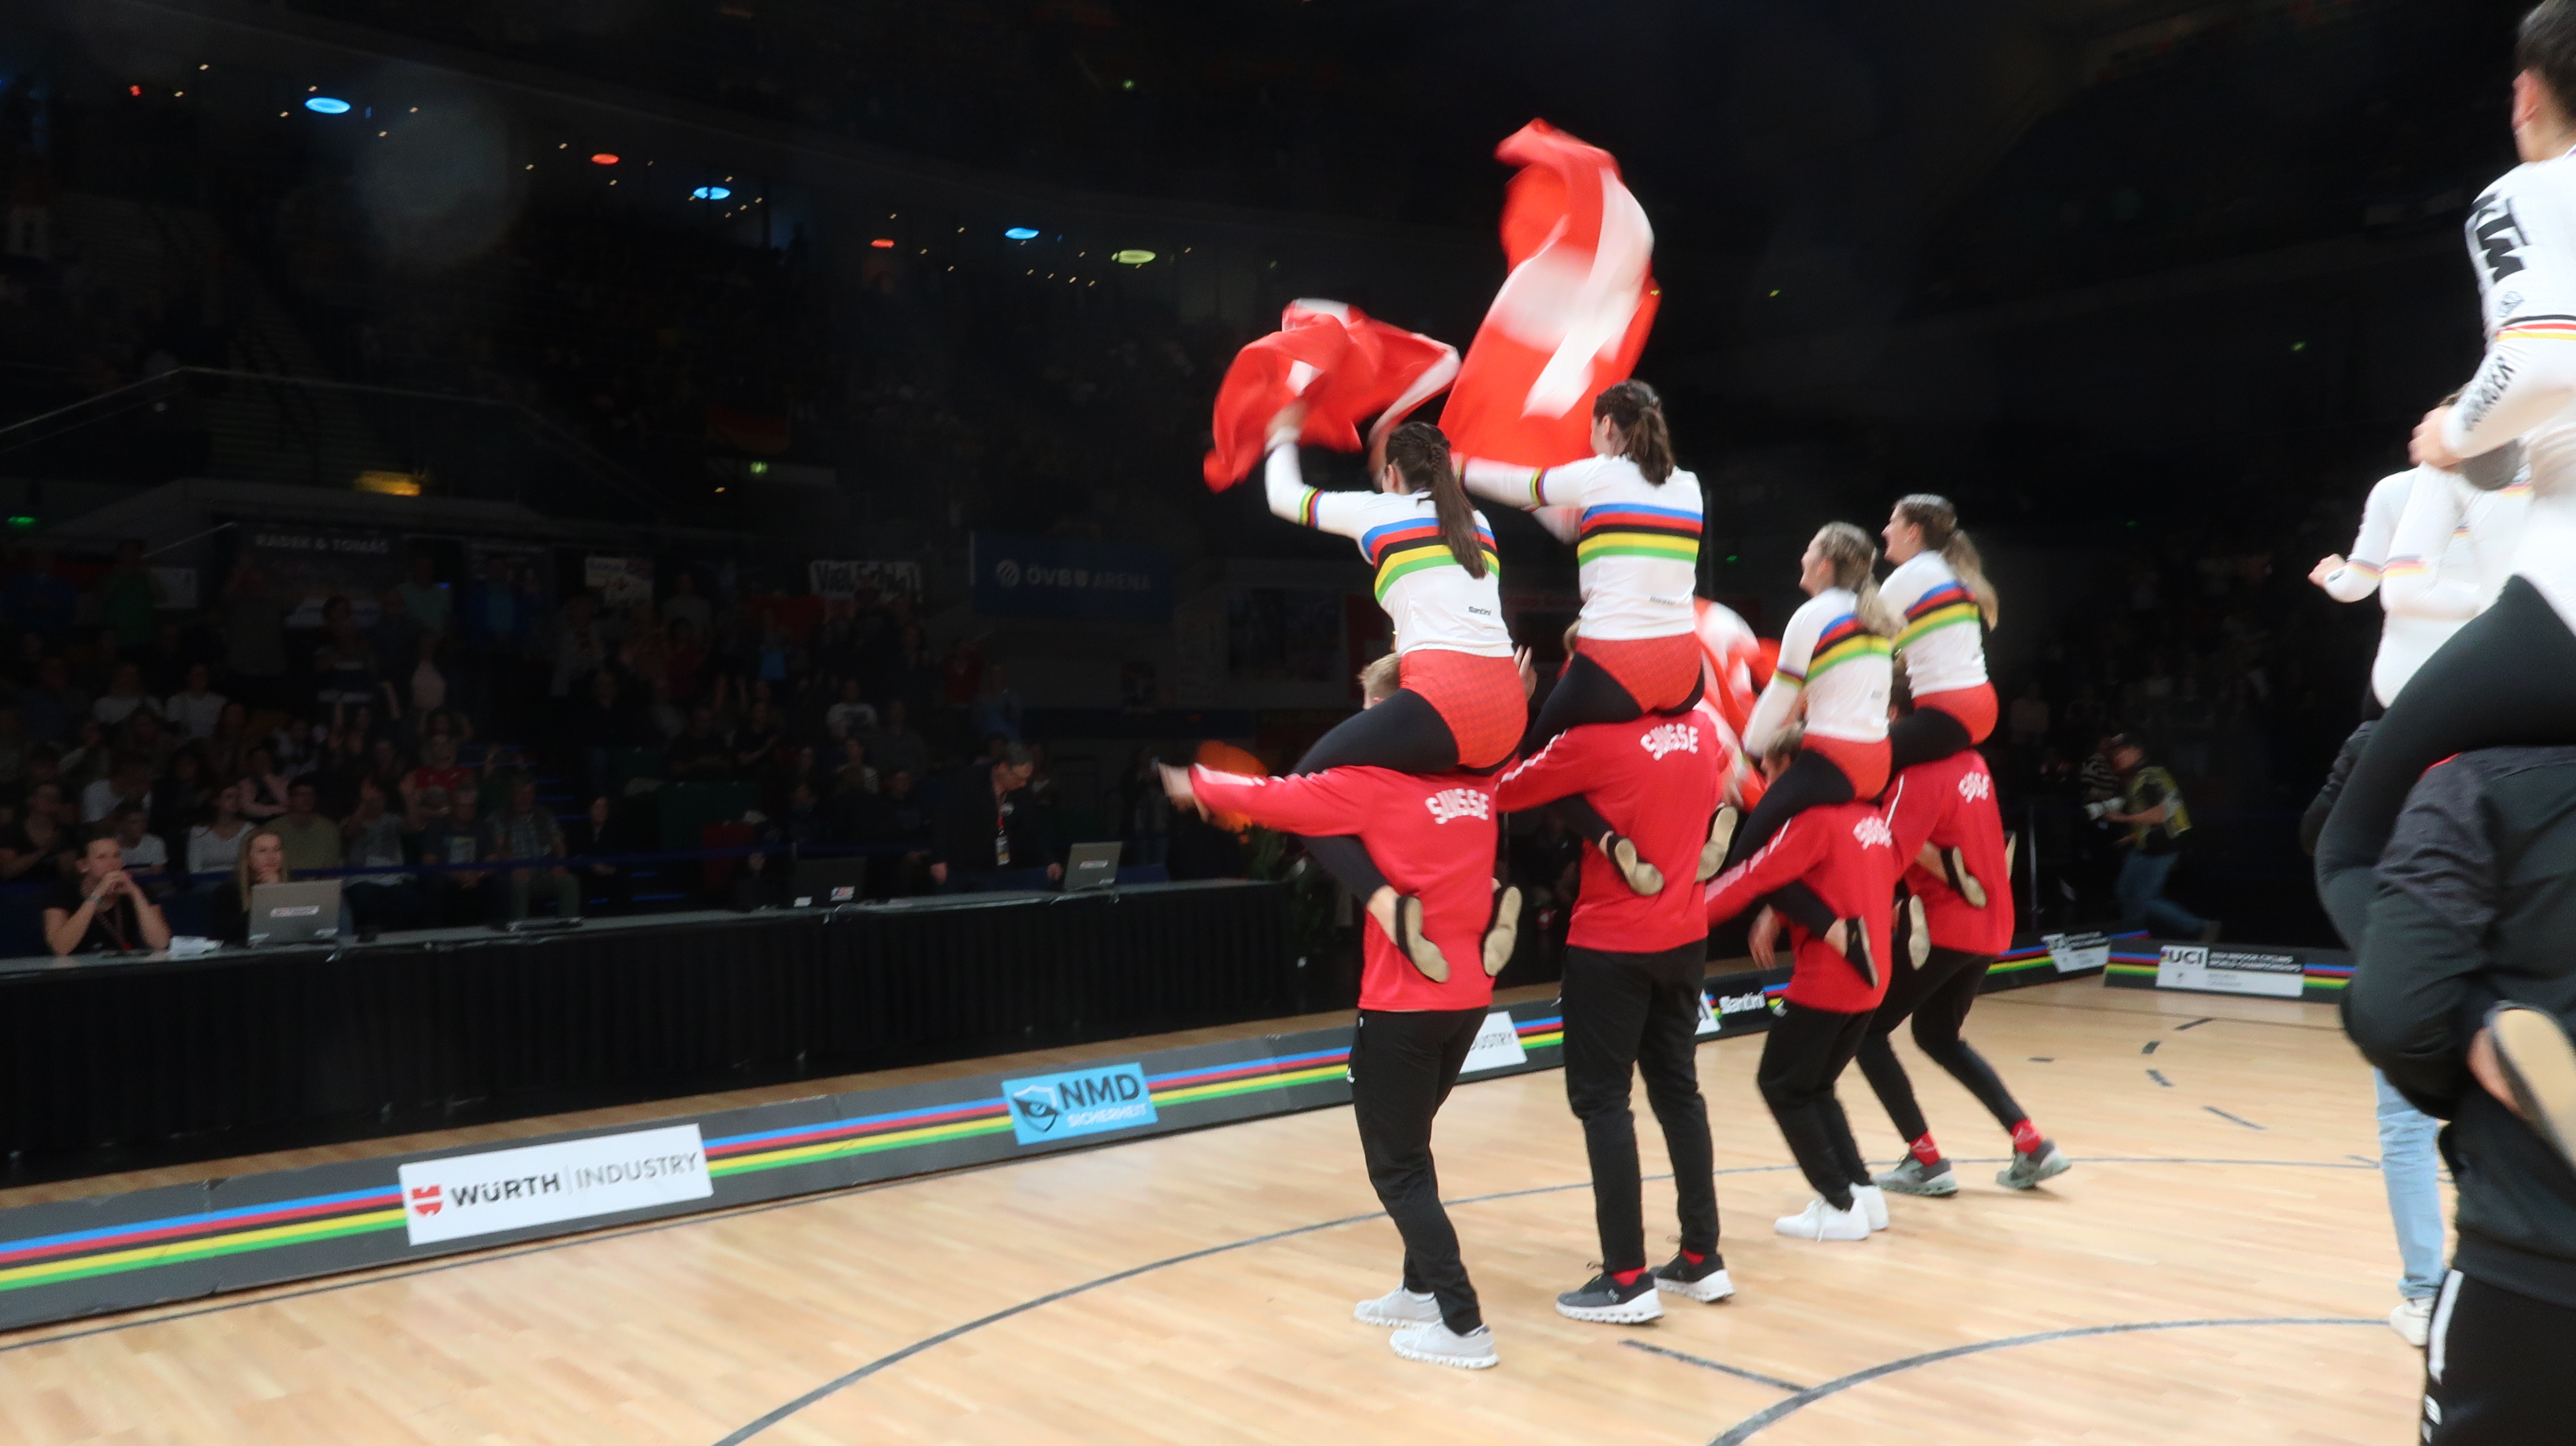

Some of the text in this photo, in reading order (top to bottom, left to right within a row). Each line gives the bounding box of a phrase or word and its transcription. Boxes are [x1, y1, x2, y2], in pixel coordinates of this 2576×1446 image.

[2471, 190, 2529, 283] KTM
[1093, 570, 1151, 591] ARENA
[1640, 723, 1699, 761] SUISSE
[1425, 788, 1489, 825] SUISSE
[2169, 950, 2203, 964] UCI
[1058, 1074, 1140, 1109] NMD
[575, 1151, 699, 1185] INDUSTRY
